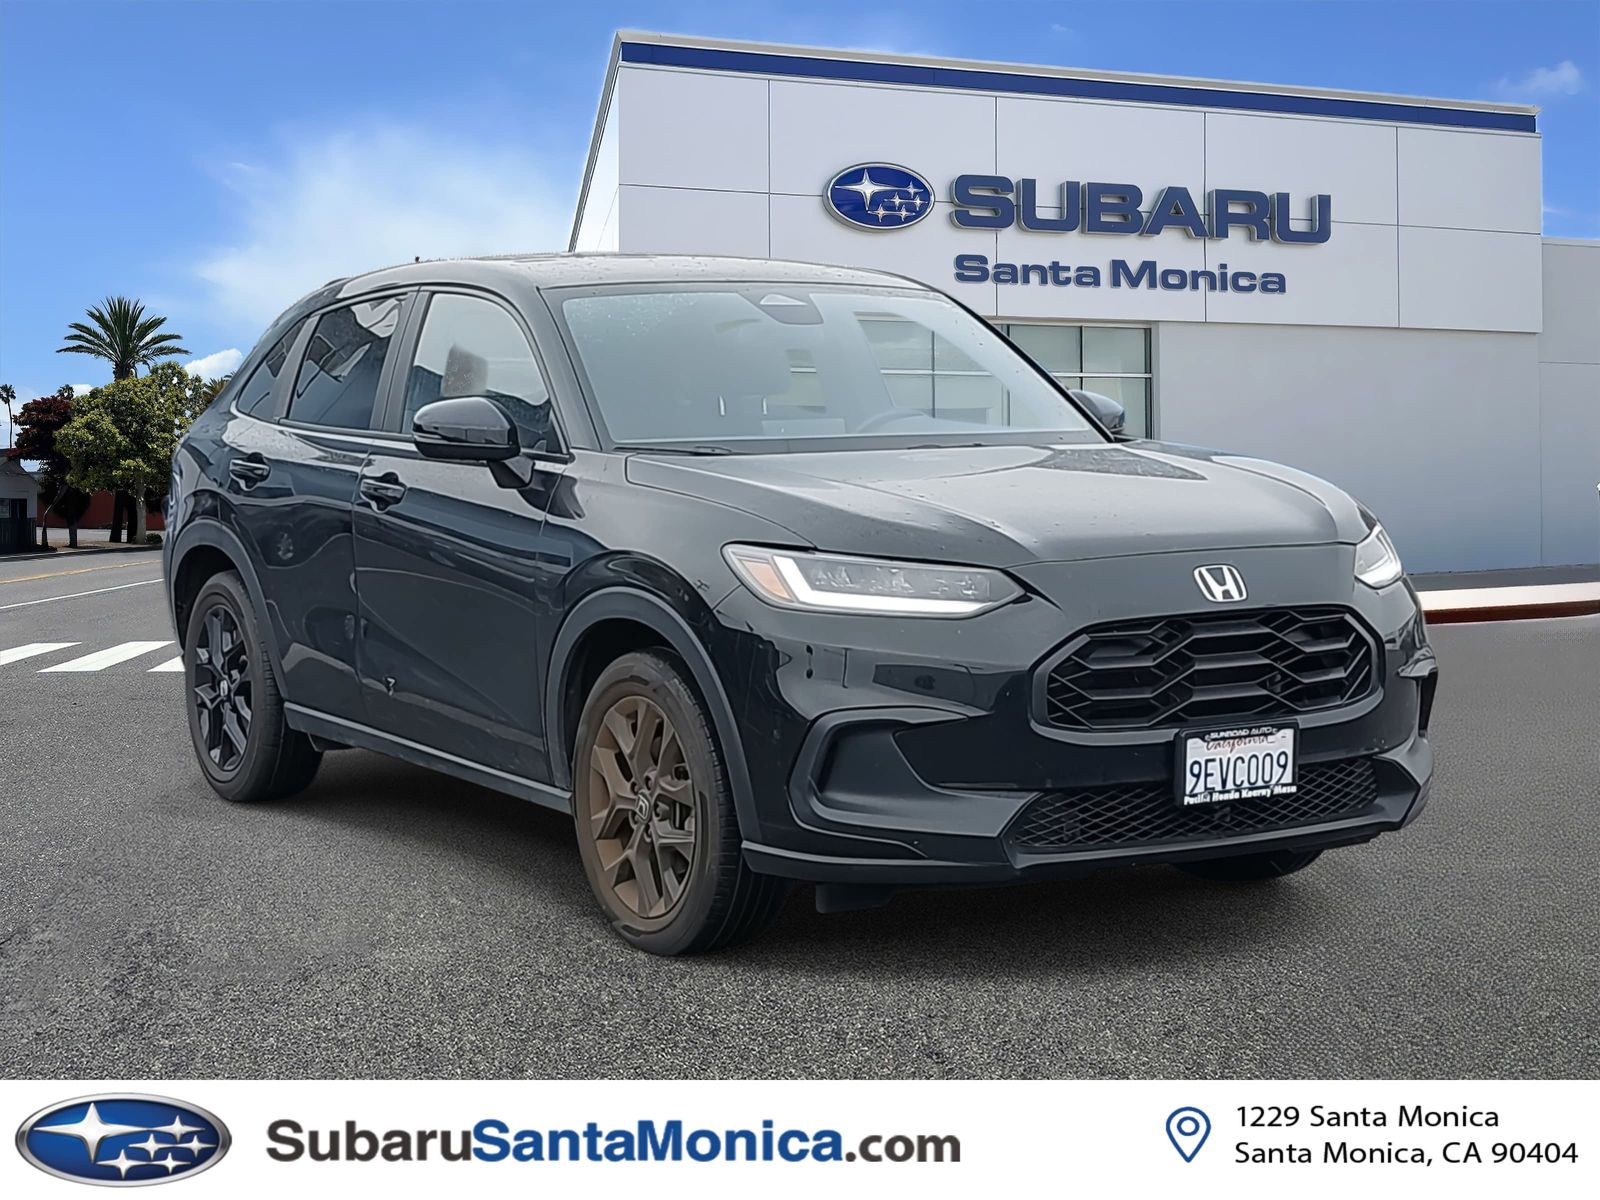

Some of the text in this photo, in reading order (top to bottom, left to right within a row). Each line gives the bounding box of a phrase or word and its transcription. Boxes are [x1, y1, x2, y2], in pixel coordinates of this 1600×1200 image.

[950, 174, 1332, 244] SUBARU
[954, 254, 1287, 294] Santa Monica
[1190, 751, 1288, 794] 9EVC009
